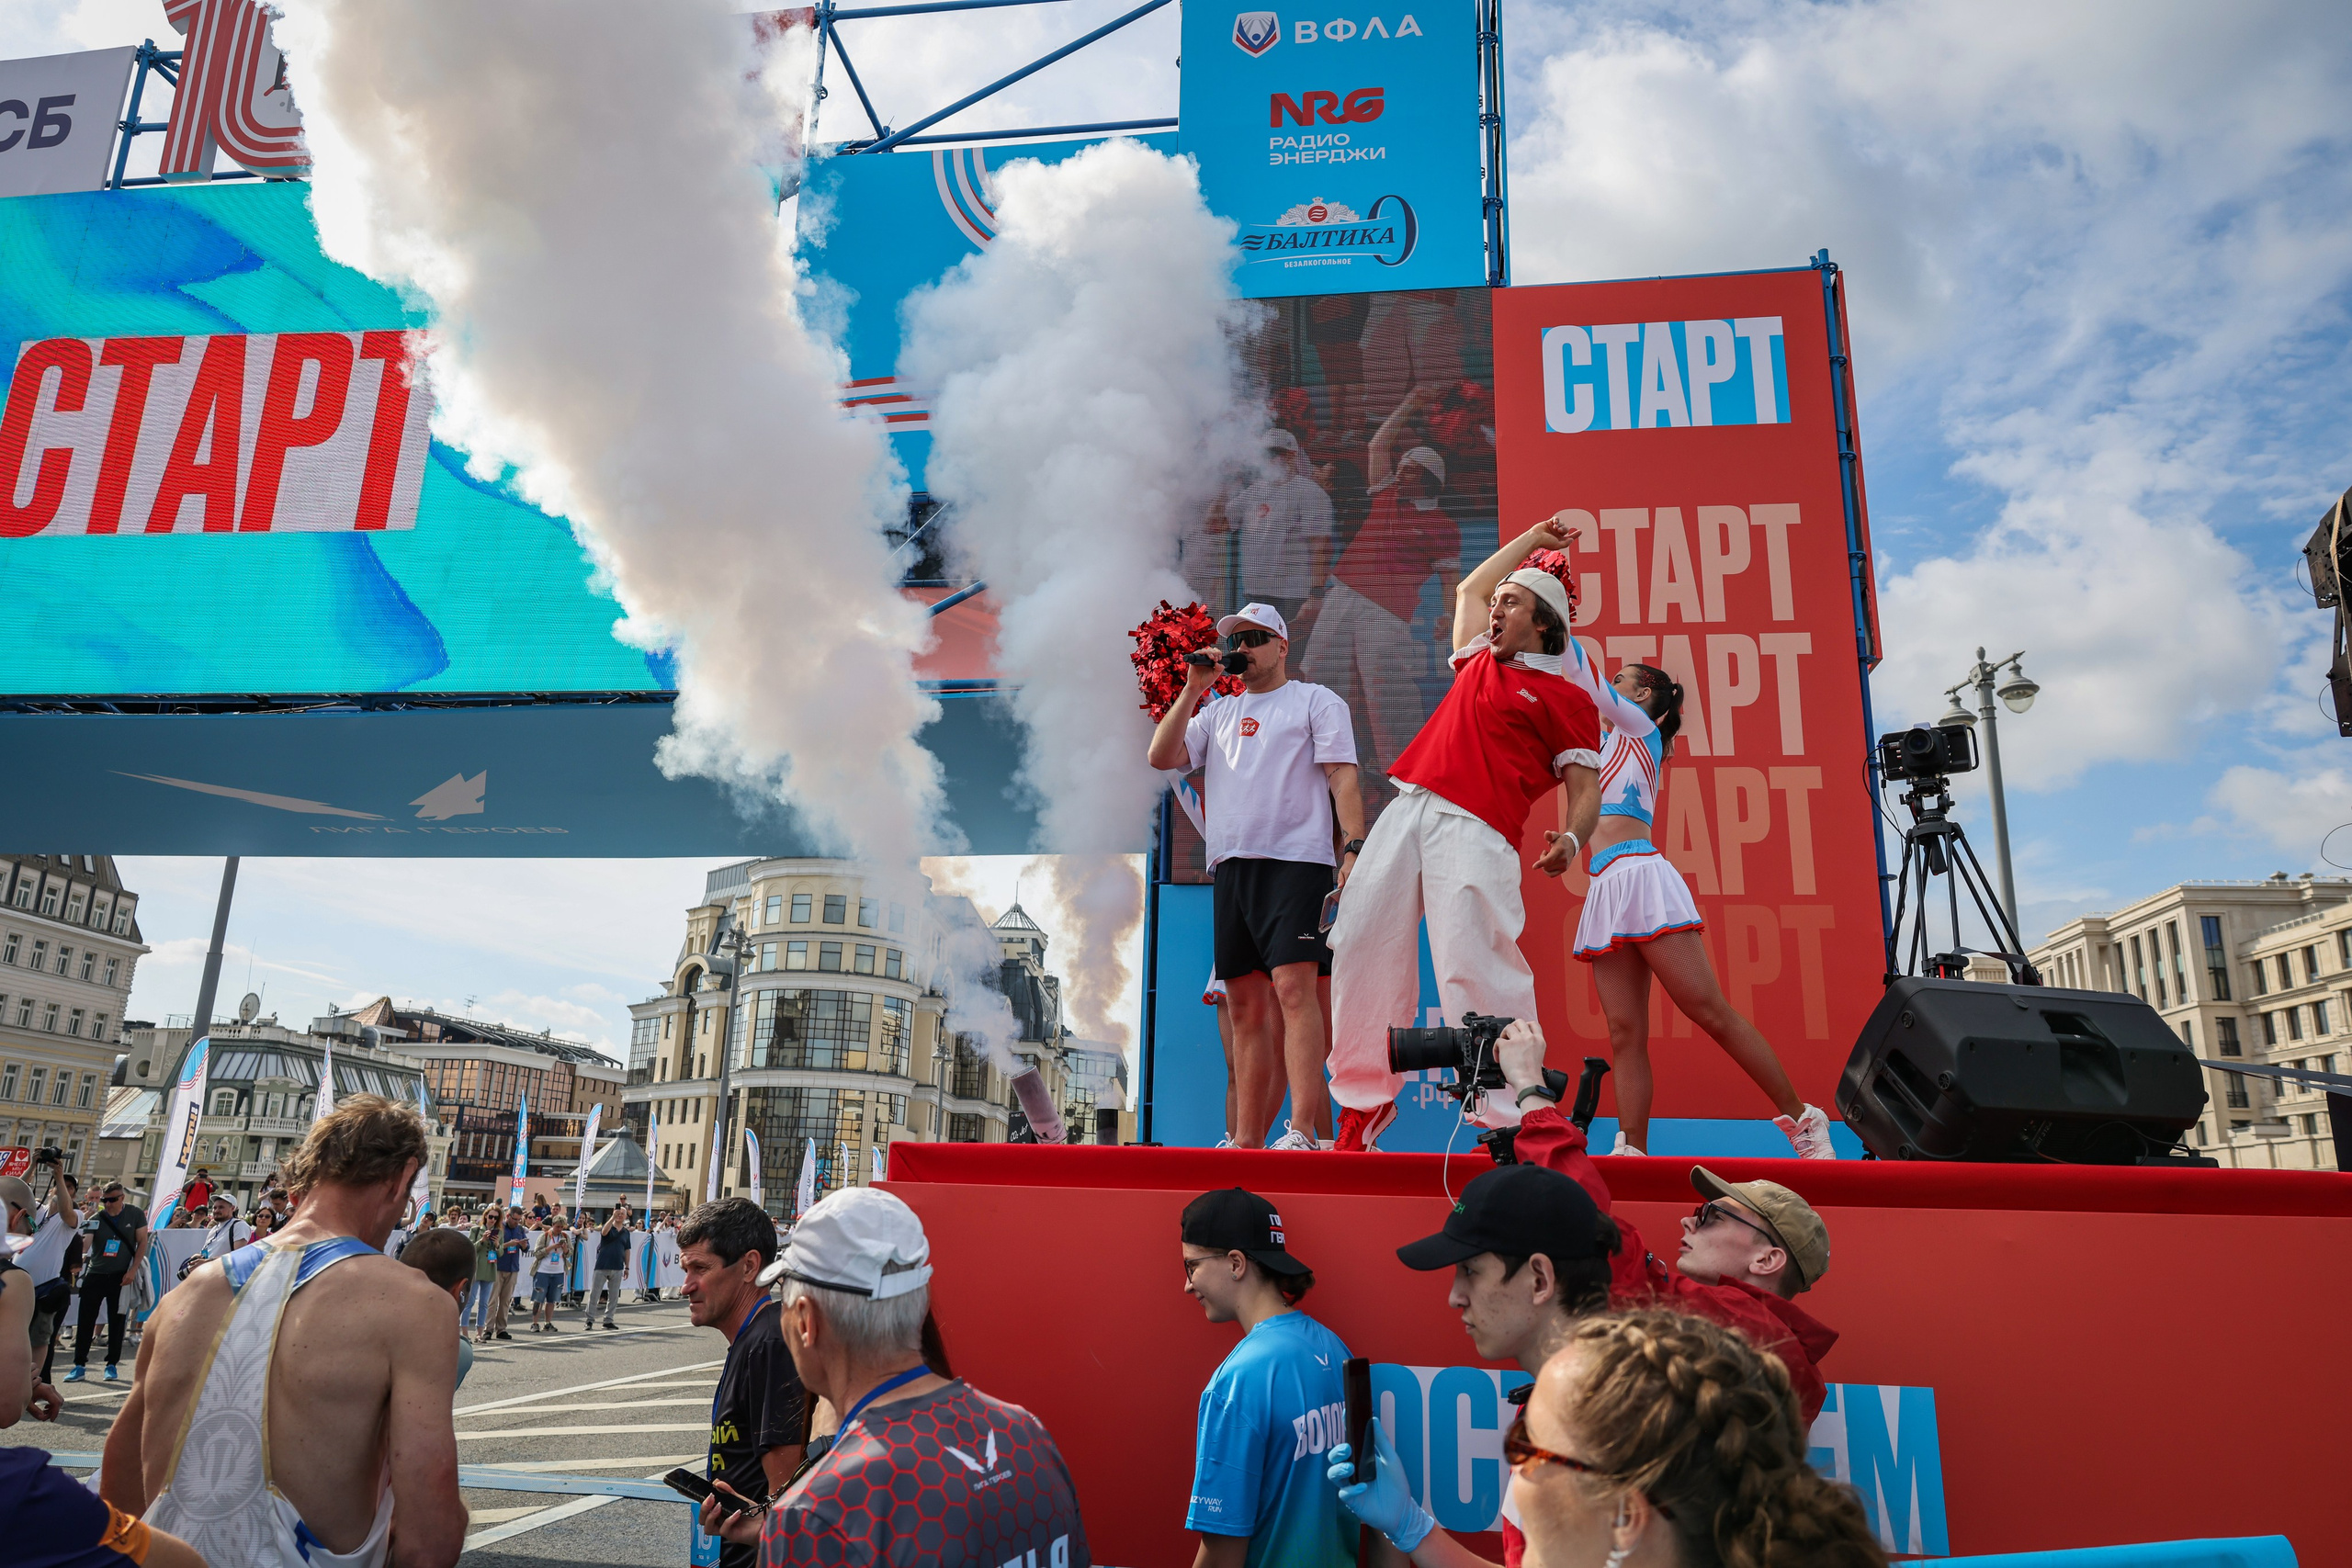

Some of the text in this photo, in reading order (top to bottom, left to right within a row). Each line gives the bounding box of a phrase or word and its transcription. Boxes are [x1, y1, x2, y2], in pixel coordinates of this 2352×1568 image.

[1295, 14, 1423, 44] ВФЛА
[1270, 87, 1385, 128] NRG
[1270, 133, 1350, 151] РАДИО
[1270, 147, 1385, 165] ЭНЕРДЖИ
[1264, 227, 1396, 251] БАЛТИКА
[1284, 258, 1351, 268] БЕЗАЛКОГОЛЬНОЕ
[1542, 316, 1784, 434] СТАРТ
[0, 329, 437, 538] СТАРТ
[988, 1470, 1012, 1484] ГЕРОЕВ
[1207, 1505, 1223, 1513] RUN
